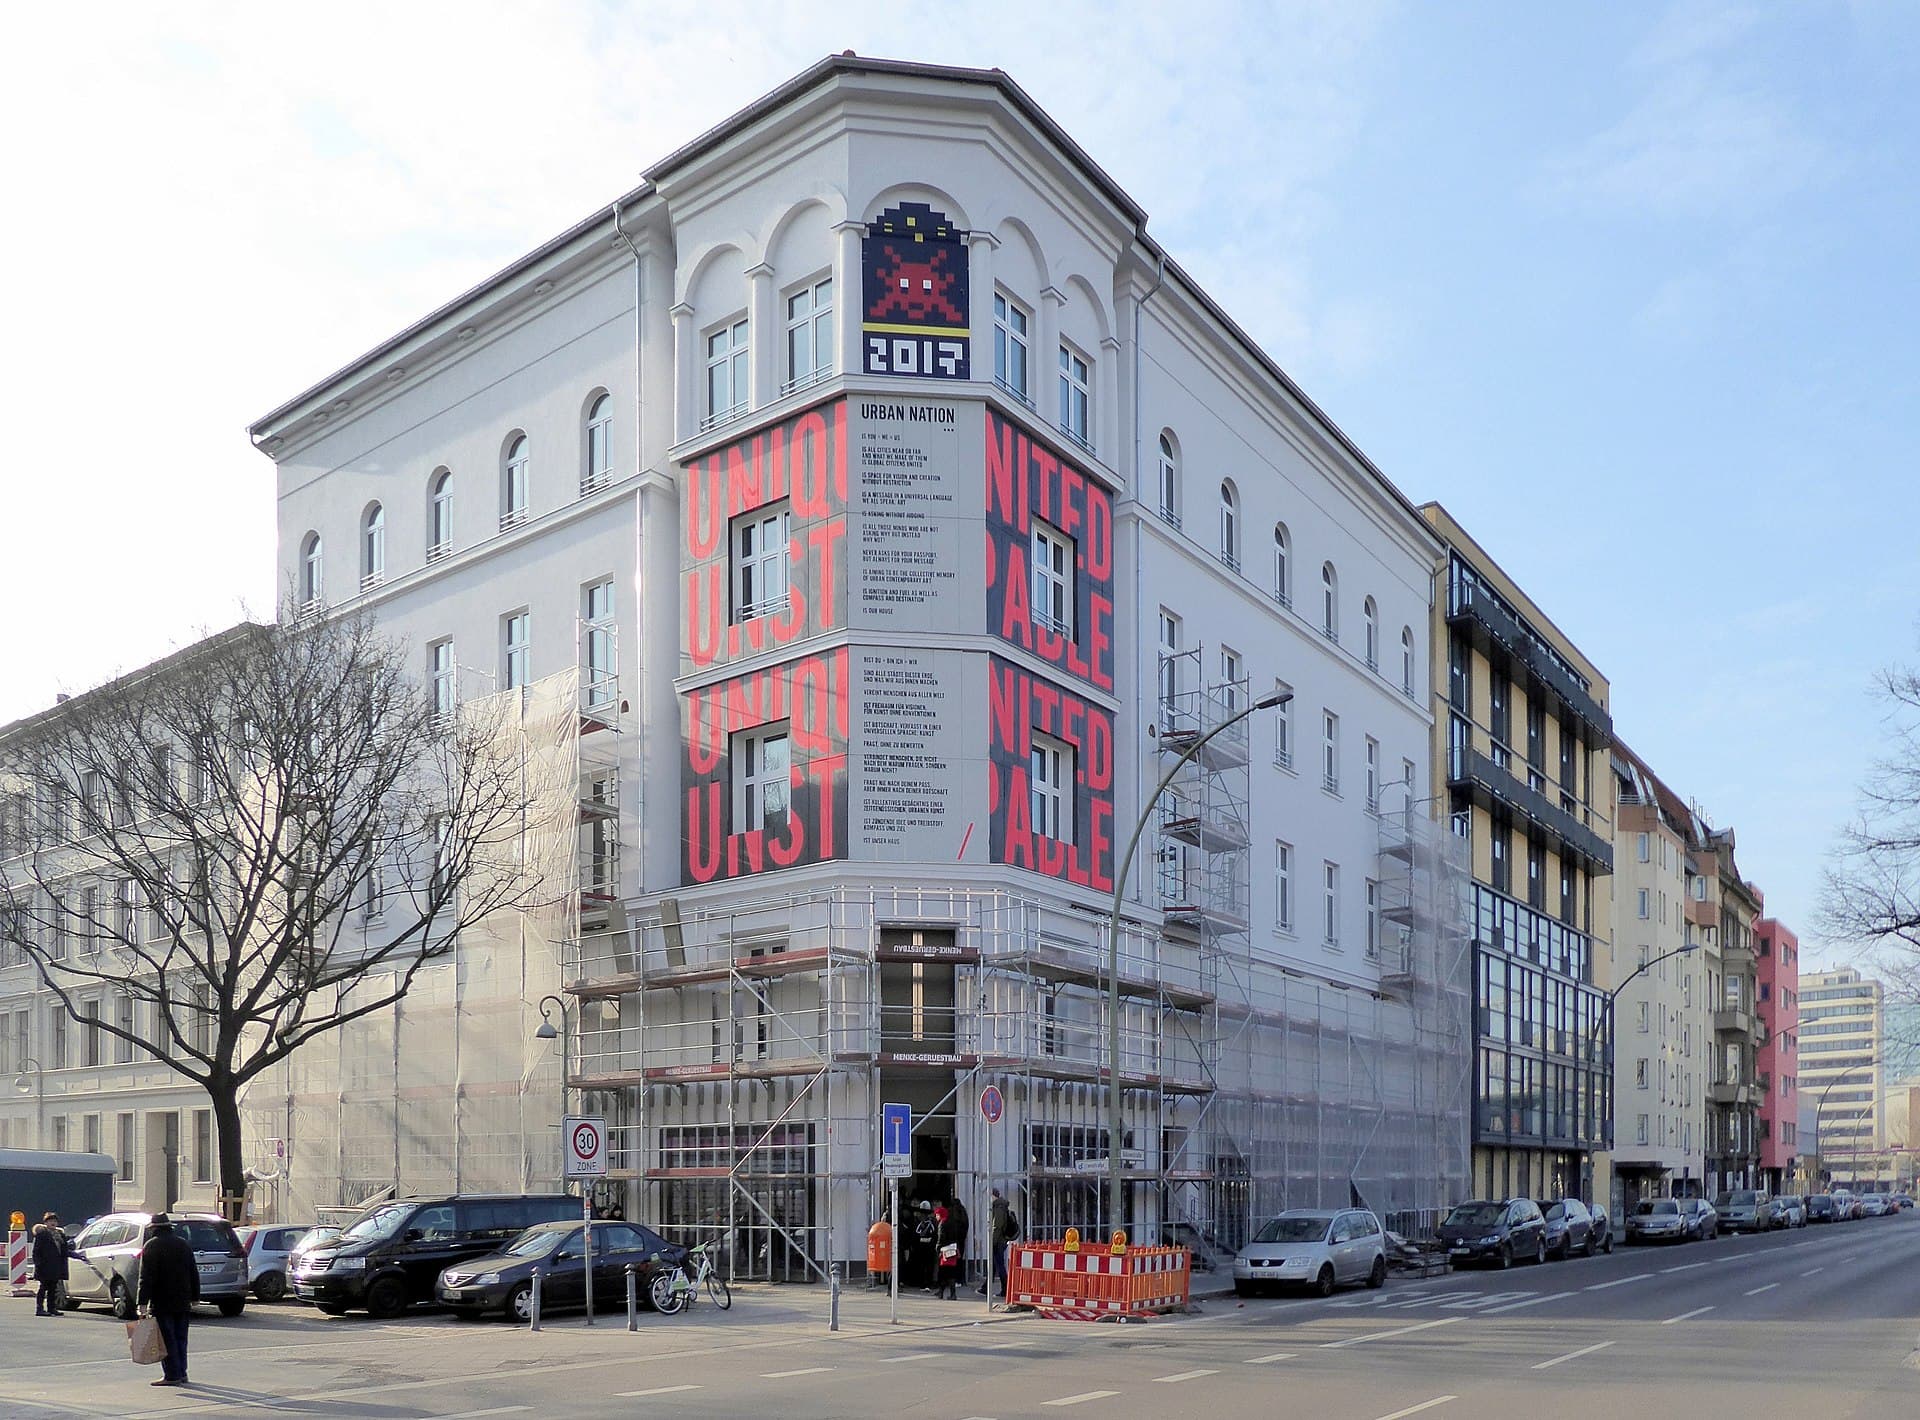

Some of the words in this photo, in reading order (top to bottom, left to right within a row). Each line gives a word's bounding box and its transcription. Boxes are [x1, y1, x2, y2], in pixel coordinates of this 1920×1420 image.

[870, 337, 963, 375] 2017
[862, 404, 904, 421] URBAN
[910, 406, 954, 423] NATION
[687, 519, 846, 666] UST
[986, 532, 1112, 690] ALE
[988, 758, 1112, 893] ALE
[578, 1132, 594, 1150] 30
[576, 1161, 597, 1172] ZONE
